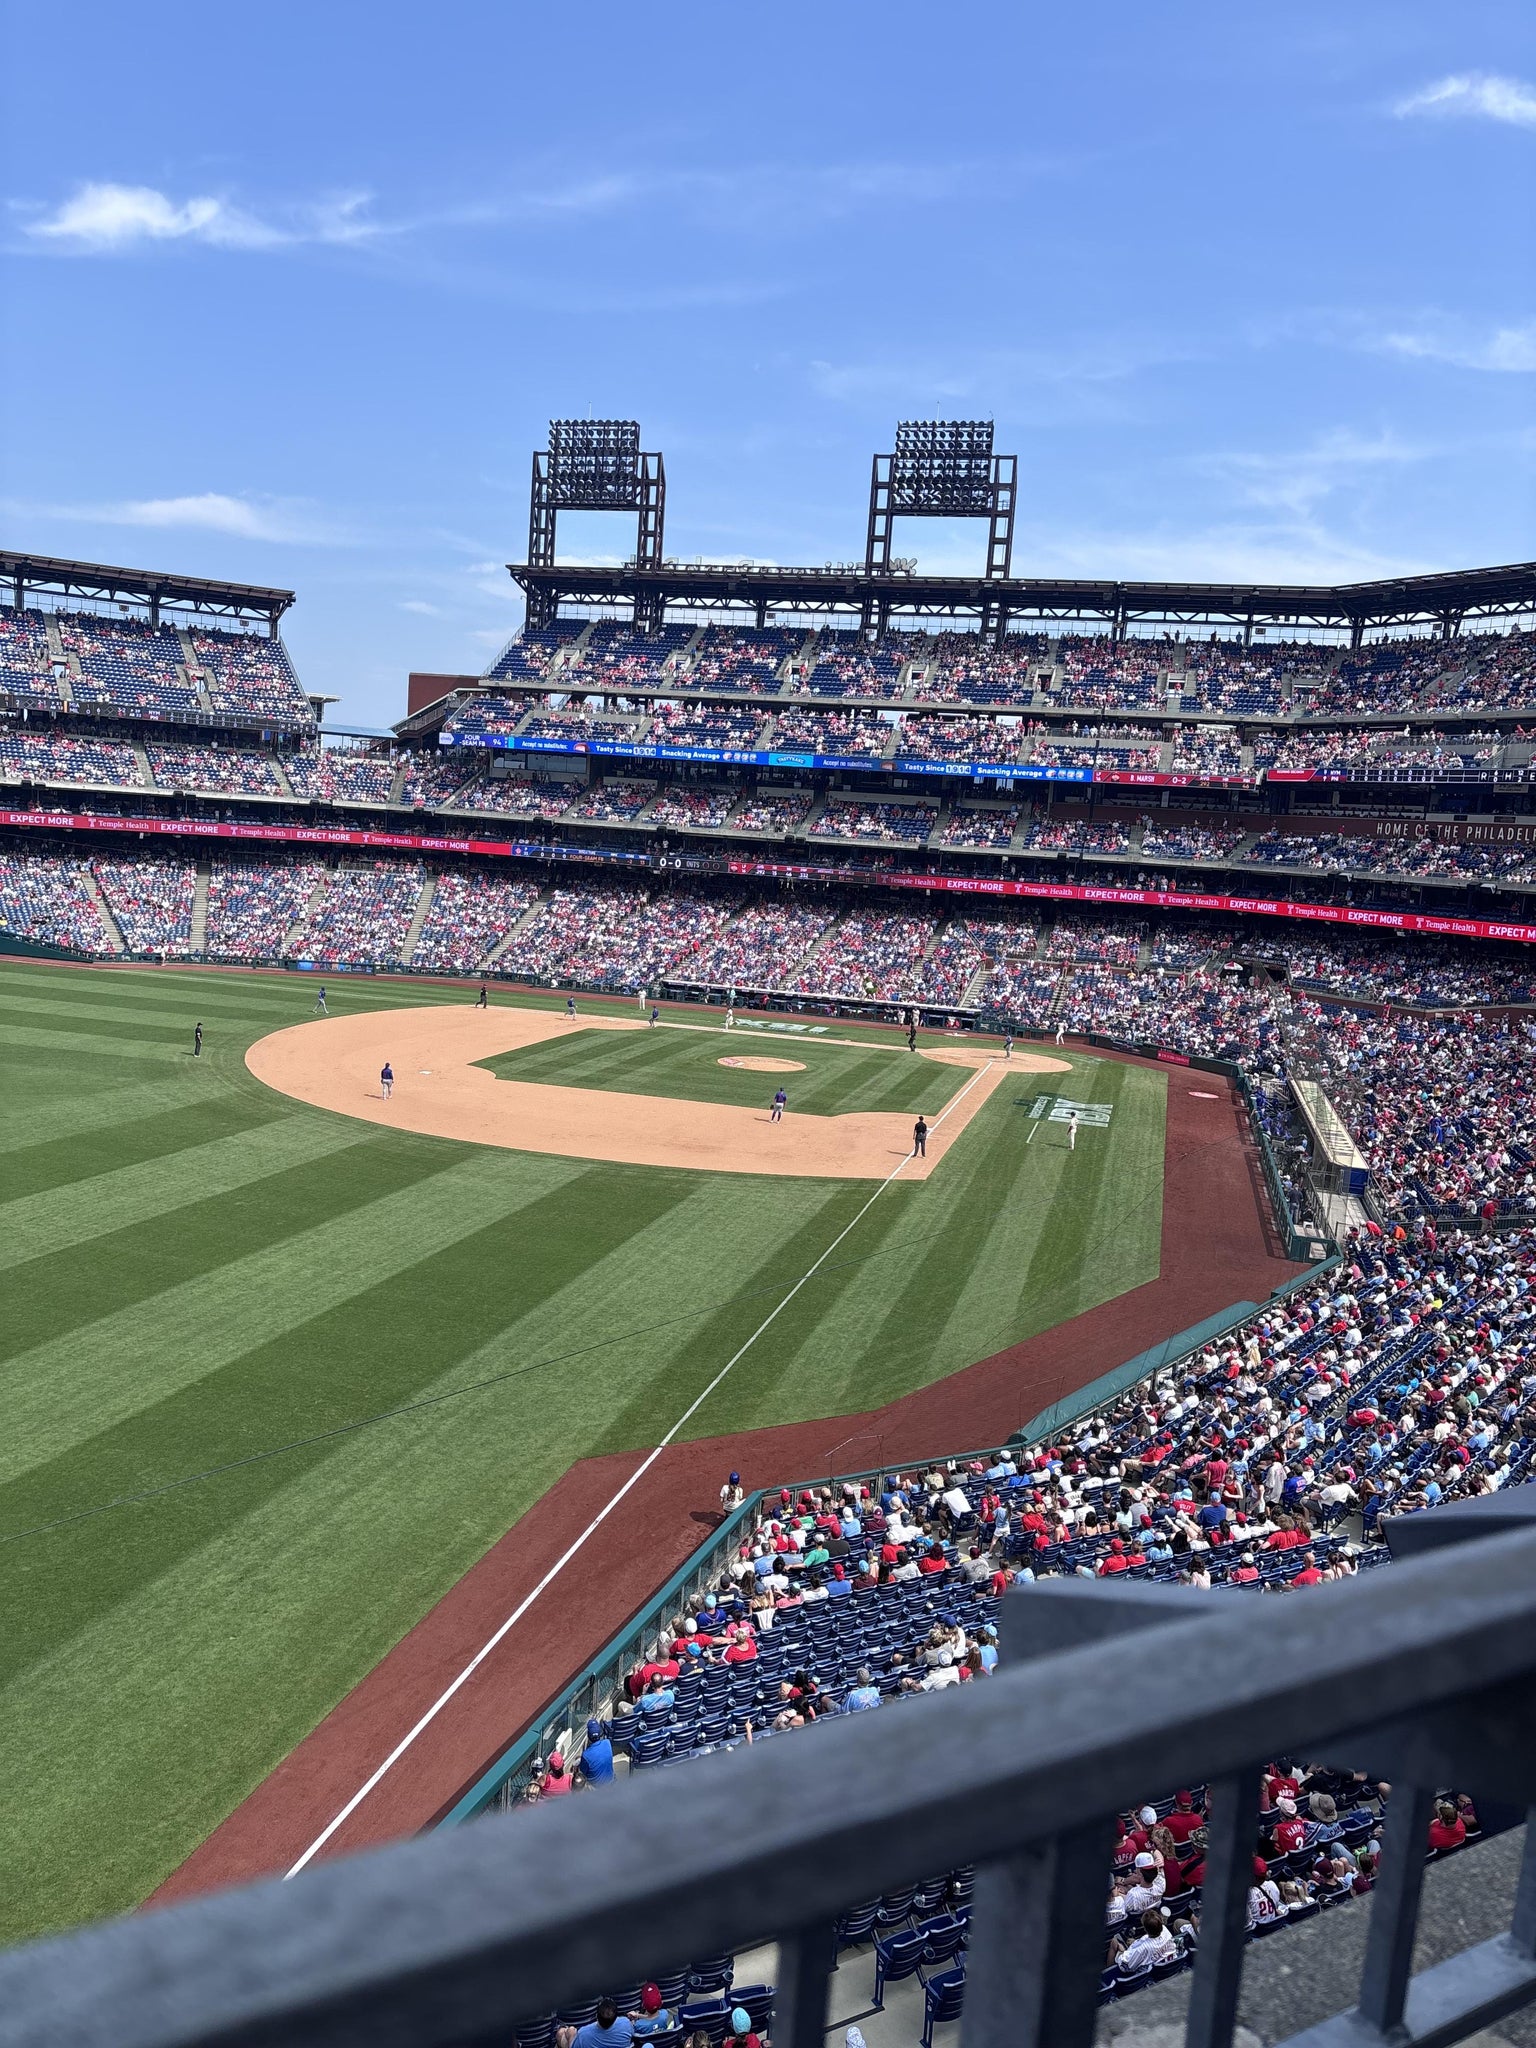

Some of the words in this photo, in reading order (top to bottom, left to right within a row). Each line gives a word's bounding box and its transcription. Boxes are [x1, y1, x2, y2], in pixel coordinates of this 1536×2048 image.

[493, 738, 502, 746] 94
[596, 745, 614, 753] Tasty
[615, 746, 632, 754] Since
[633, 747, 656, 756] 1914
[662, 749, 692, 759] Snacking
[693, 751, 720, 760] Average
[823, 759, 839, 767] Accept
[904, 763, 924, 772] Tasty
[946, 765, 971, 774] 1914
[977, 767, 1010, 777] Snacking
[1012, 769, 1043, 778] Average
[1136, 775, 1155, 783] MARSH
[1172, 776, 1187, 785] 0-2
[1480, 770, 1487, 781] R
[1505, 770, 1512, 781] H
[1529, 770, 1536, 781] E
[10, 814, 46, 824] EXPECT
[48, 816, 75, 826] MORE
[98, 820, 124, 829] Temple
[126, 821, 149, 830] Health
[160, 823, 192, 832] EXPECT
[195, 825, 219, 834] MORE
[240, 828, 264, 837] Temple
[264, 829, 286, 837] Health
[1376, 822, 1409, 836] HOME
[1437, 824, 1459, 838] THE
[296, 831, 327, 840] EXPECT
[328, 832, 351, 841] MORE
[371, 836, 393, 845] Temple
[393, 837, 413, 845] Health
[421, 839, 448, 848] EXPECT
[449, 842, 470, 850] MORE
[660, 858, 682, 868] 0-0
[890, 877, 914, 886] Temple
[915, 878, 936, 887] Health
[947, 880, 979, 890] EXPECT
[980, 882, 1004, 892] MORE
[1024, 886, 1048, 895] Temple
[1050, 887, 1073, 896] Health
[1085, 889, 1118, 899] EXPECT
[1119, 892, 1145, 901] MORE
[1168, 895, 1194, 906] Temple
[1195, 897, 1219, 906] Health
[1230, 900, 1256, 910] EXPECT
[1257, 902, 1278, 912] MORE
[1295, 906, 1317, 917] Temple
[1317, 908, 1338, 918] Health
[1348, 911, 1378, 923] EXPECT
[1379, 914, 1404, 925] MORE
[1425, 920, 1451, 930] Temple
[1452, 922, 1476, 933] Health
[1488, 926, 1525, 938] EXPECT
[1277, 1789, 1295, 1798] MARSH
